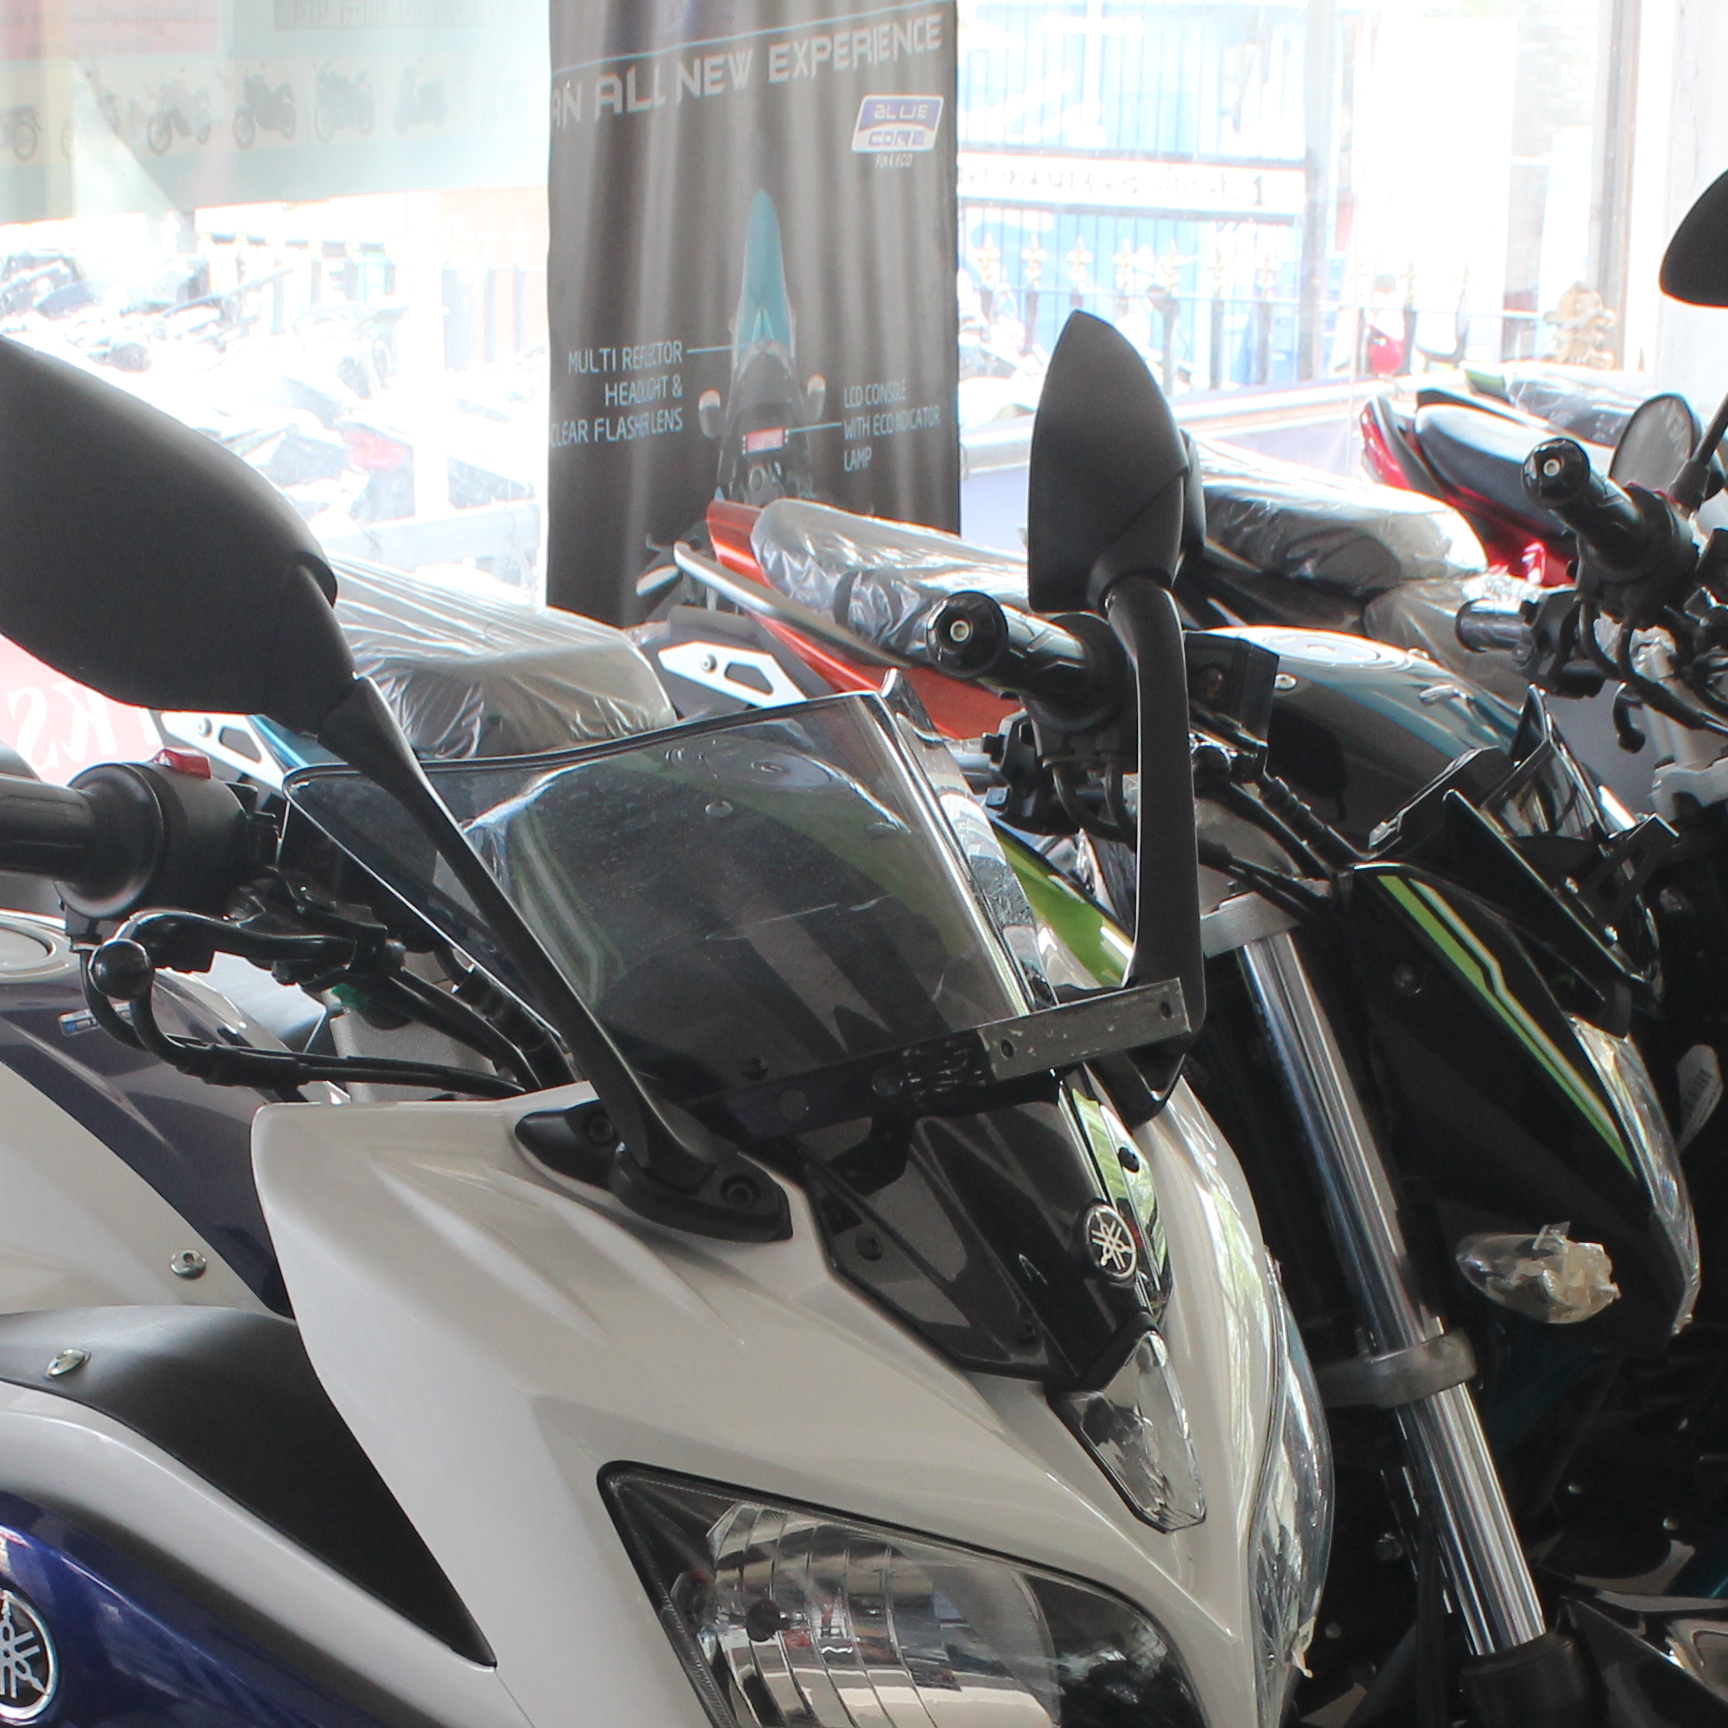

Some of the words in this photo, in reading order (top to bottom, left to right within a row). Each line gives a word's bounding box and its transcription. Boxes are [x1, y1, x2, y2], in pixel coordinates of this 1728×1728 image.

[594, 66, 667, 121] ALL
[675, 48, 753, 105] NEW
[768, 13, 944, 85] EXPERIENCE
[874, 103, 929, 119] BLUE
[868, 129, 926, 146] CORE
[568, 346, 617, 375] MULTI
[843, 385, 863, 409] LCD
[651, 408, 684, 435] LENS
[843, 415, 871, 440] WITH
[873, 413, 894, 436] ECO
[843, 445, 873, 473] LAMP
